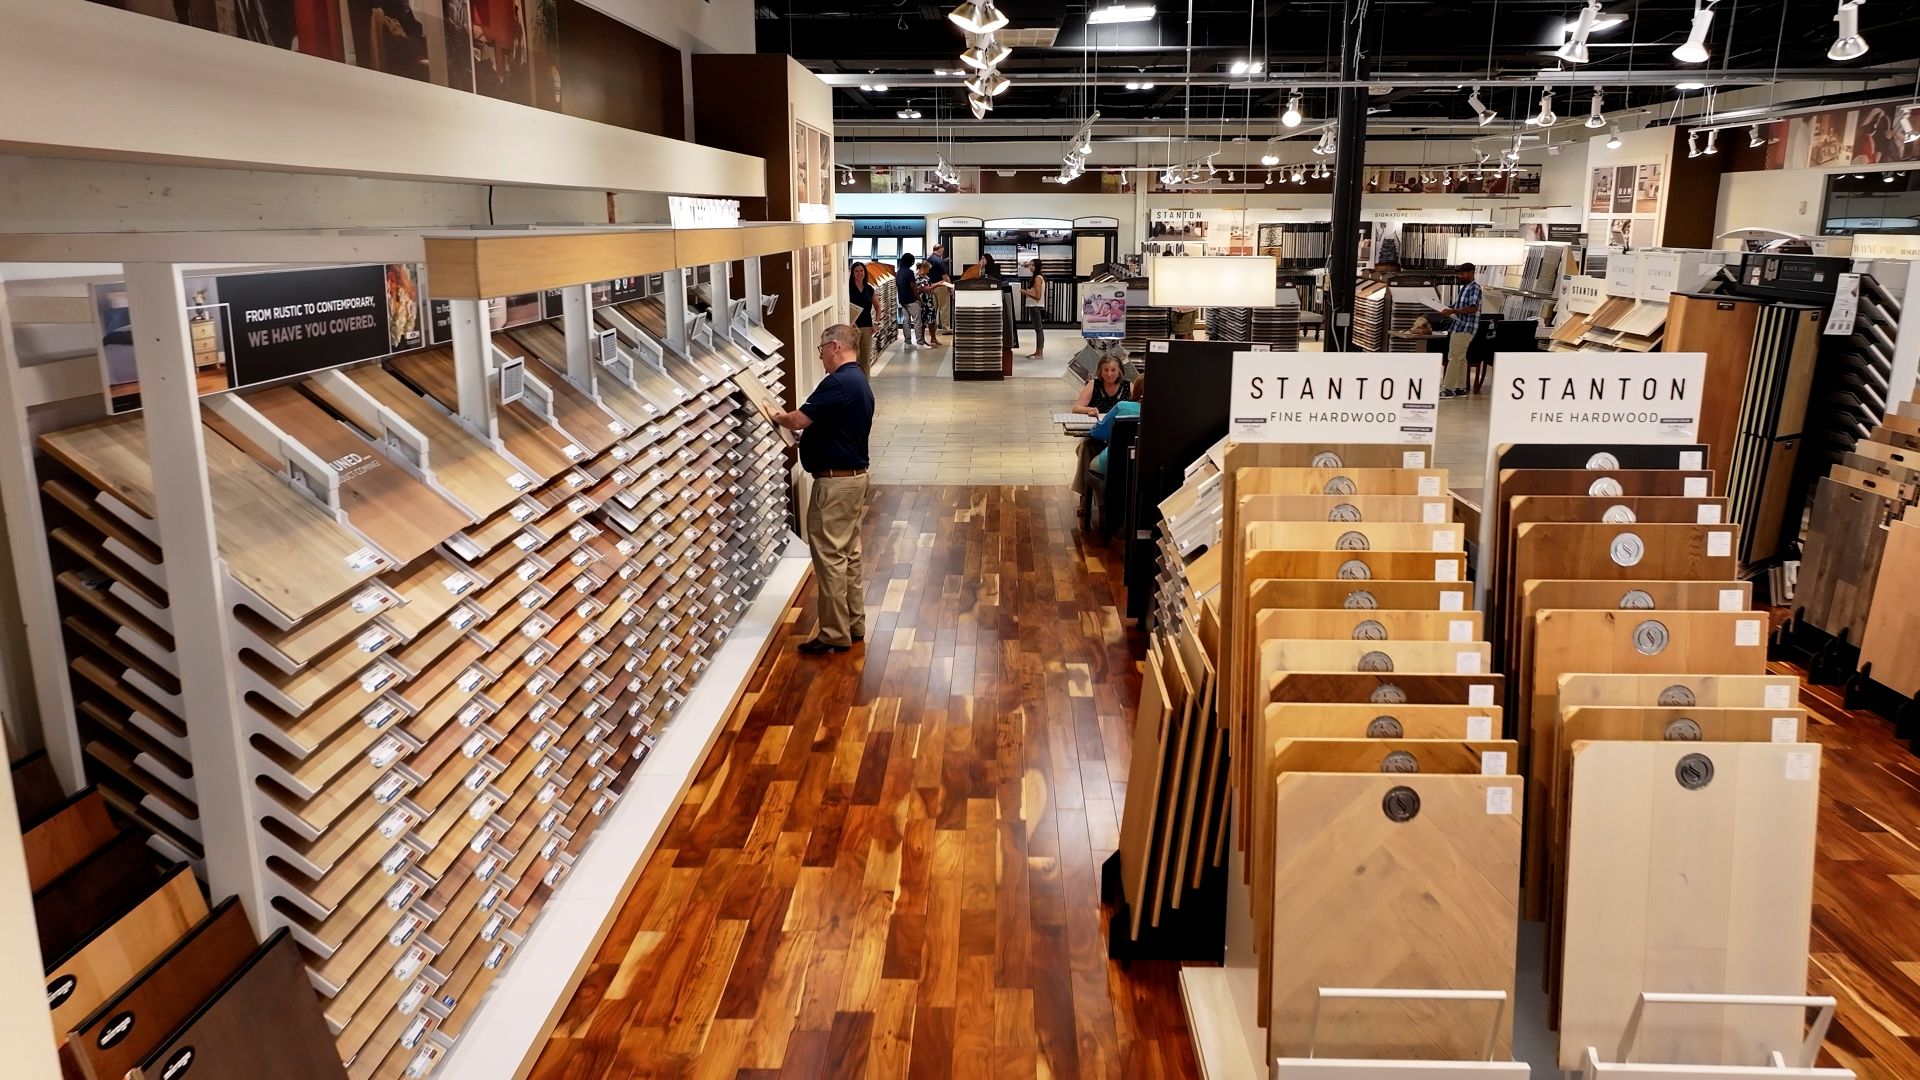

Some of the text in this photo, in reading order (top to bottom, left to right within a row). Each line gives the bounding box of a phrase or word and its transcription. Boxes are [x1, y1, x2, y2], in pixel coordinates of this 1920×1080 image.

[1572, 286, 1598, 297] STANTON
[246, 296, 376, 322] FROM RUSTIC TO CONTEMPORARY,
[248, 314, 376, 348] WE HAVE YOU COVERED.
[1250, 376, 1423, 400] STANTON
[1511, 378, 1686, 400] STANTON
[1270, 412, 1302, 422] FINE
[1309, 412, 1397, 423] HARDWOOD
[1530, 412, 1564, 422] FINE
[1570, 412, 1658, 423] HARDWOOD
